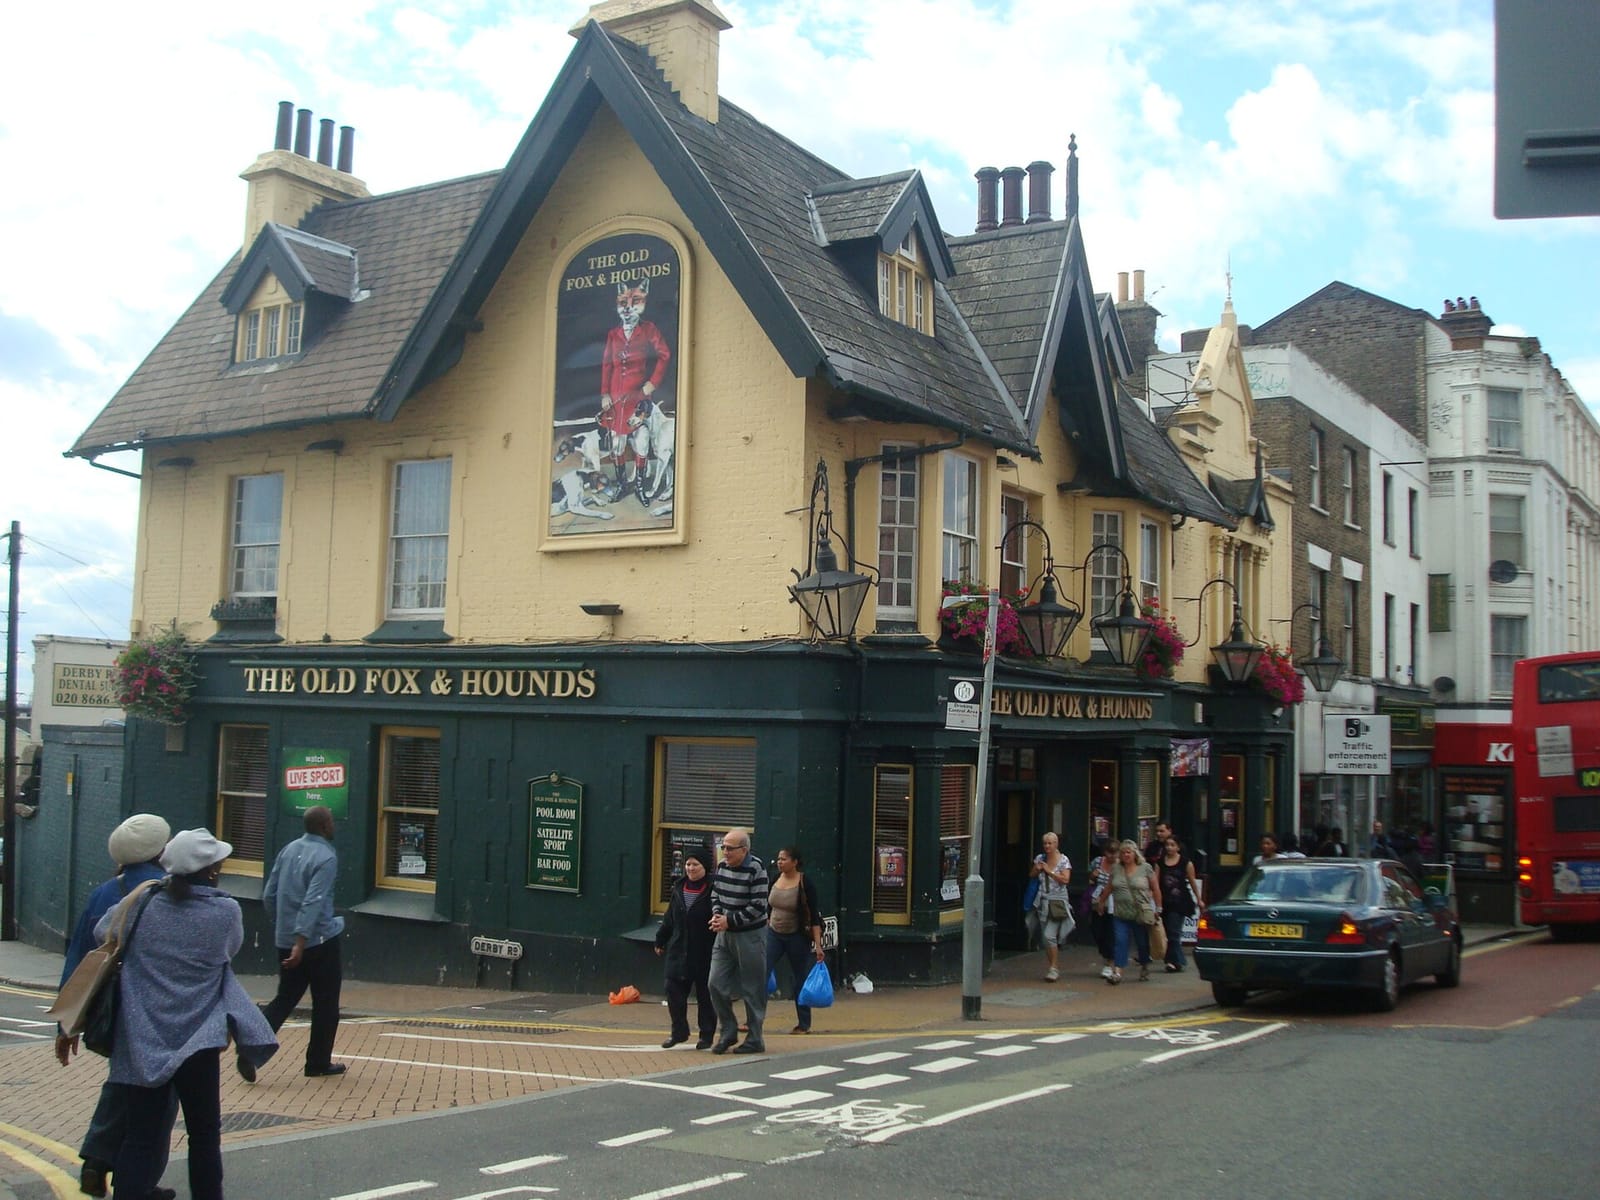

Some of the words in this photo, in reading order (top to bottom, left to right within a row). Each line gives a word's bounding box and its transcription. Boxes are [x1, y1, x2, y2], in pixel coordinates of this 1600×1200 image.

[588, 254, 617, 270] THE
[620, 249, 649, 266] OLD
[566, 275, 593, 291] FOX
[596, 273, 607, 286] &
[611, 263, 671, 284] HOUNDS
[63, 667, 103, 679] DERBY
[58, 679, 95, 690] DENTAL
[244, 667, 296, 692] THE
[301, 667, 357, 693] OLD
[363, 668, 422, 695] FOX
[430, 669, 453, 695] &
[459, 669, 596, 698] HOUNDS
[56, 693, 78, 704] 020
[82, 694, 110, 705] 8686
[990, 688, 1012, 714] HE
[1015, 690, 1048, 716] OLD
[1053, 694, 1082, 718] FOX
[1086, 695, 1098, 719] &
[1101, 698, 1153, 719] HOUNDS
[1342, 742, 1373, 750] Traffic
[1328, 752, 1388, 760] enforcement
[289, 771, 308, 785] LIVE
[311, 769, 341, 783] SPORT
[536, 807, 555, 818] POOL
[555, 808, 576, 820] ROOM
[537, 827, 573, 840] SATELLITE
[543, 839, 567, 851] SPORT
[537, 858, 551, 869] BAR
[552, 860, 571, 871] FOOD
[474, 941, 504, 954] DERBY
